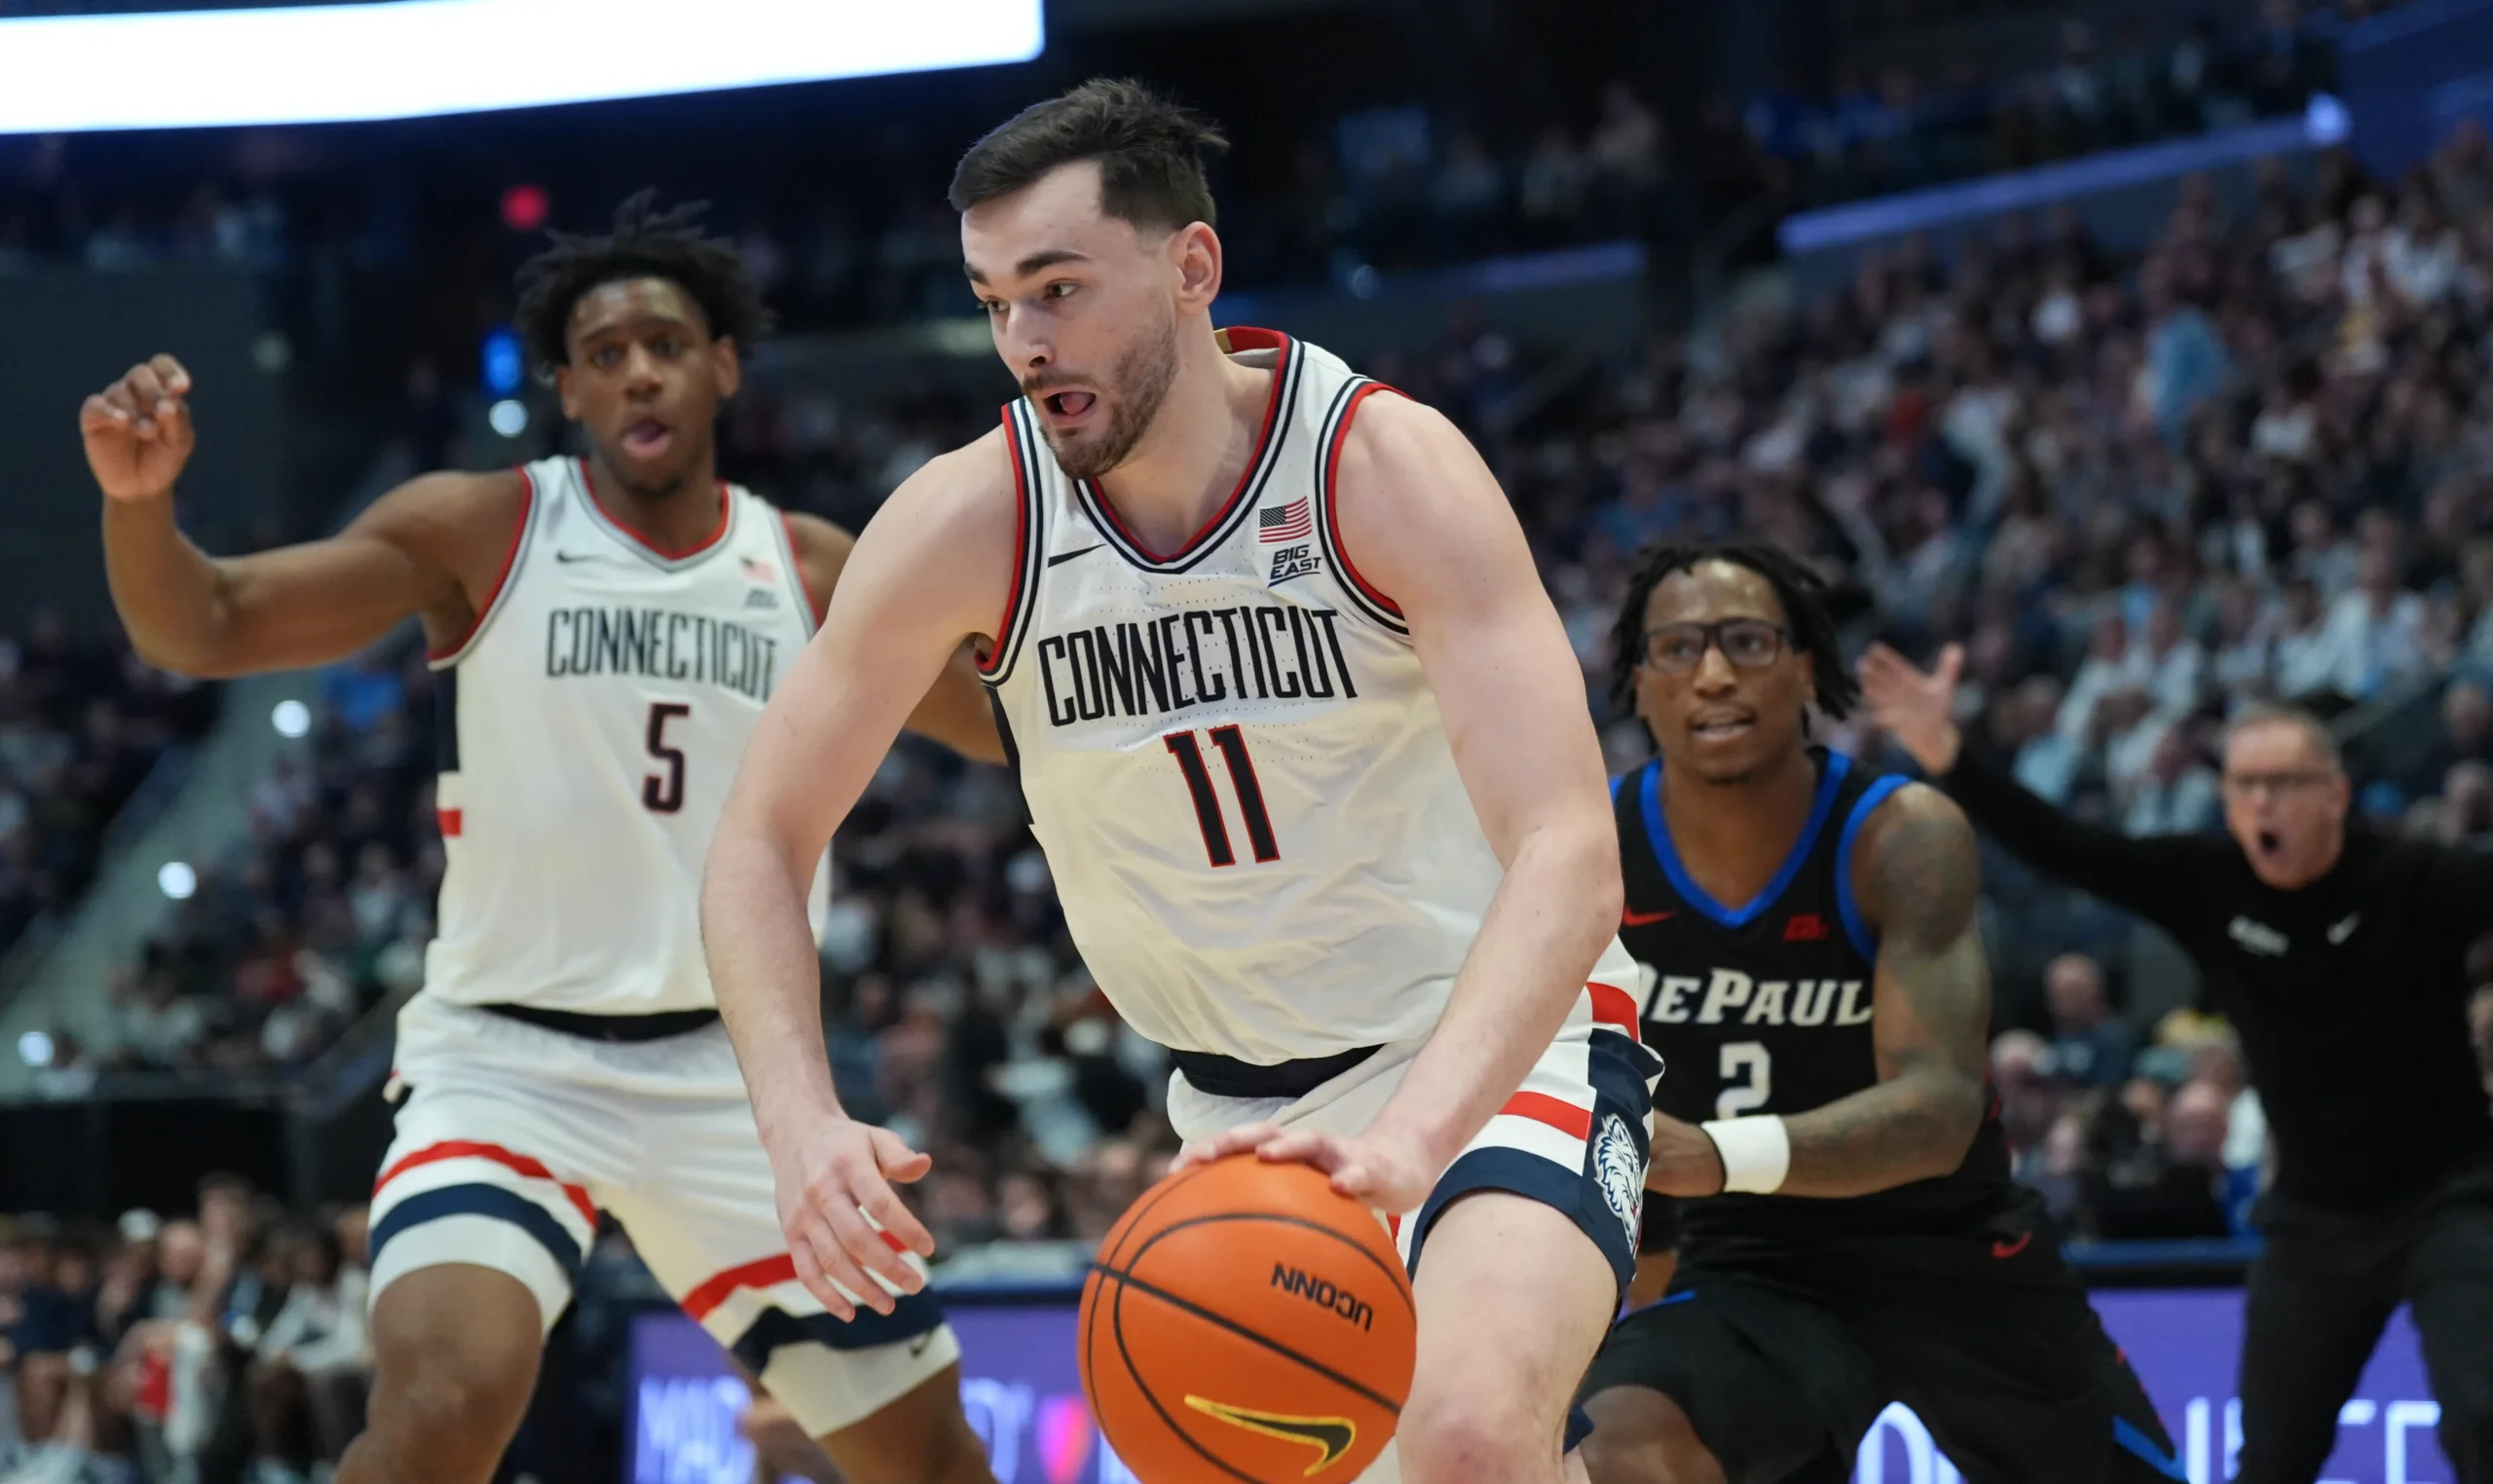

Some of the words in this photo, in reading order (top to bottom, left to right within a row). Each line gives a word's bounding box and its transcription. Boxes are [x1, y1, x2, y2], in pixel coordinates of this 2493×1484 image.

[1270, 557, 1321, 580] EAST
[1272, 543, 1311, 565] BIG
[545, 606, 777, 703] CONNECTICUT
[1037, 606, 1358, 727] CONNECTICUT
[642, 701, 690, 816] 5
[1163, 723, 1282, 869] 11
[1715, 1041, 1771, 1121] 2
[1270, 1262, 1374, 1333] UCONN
